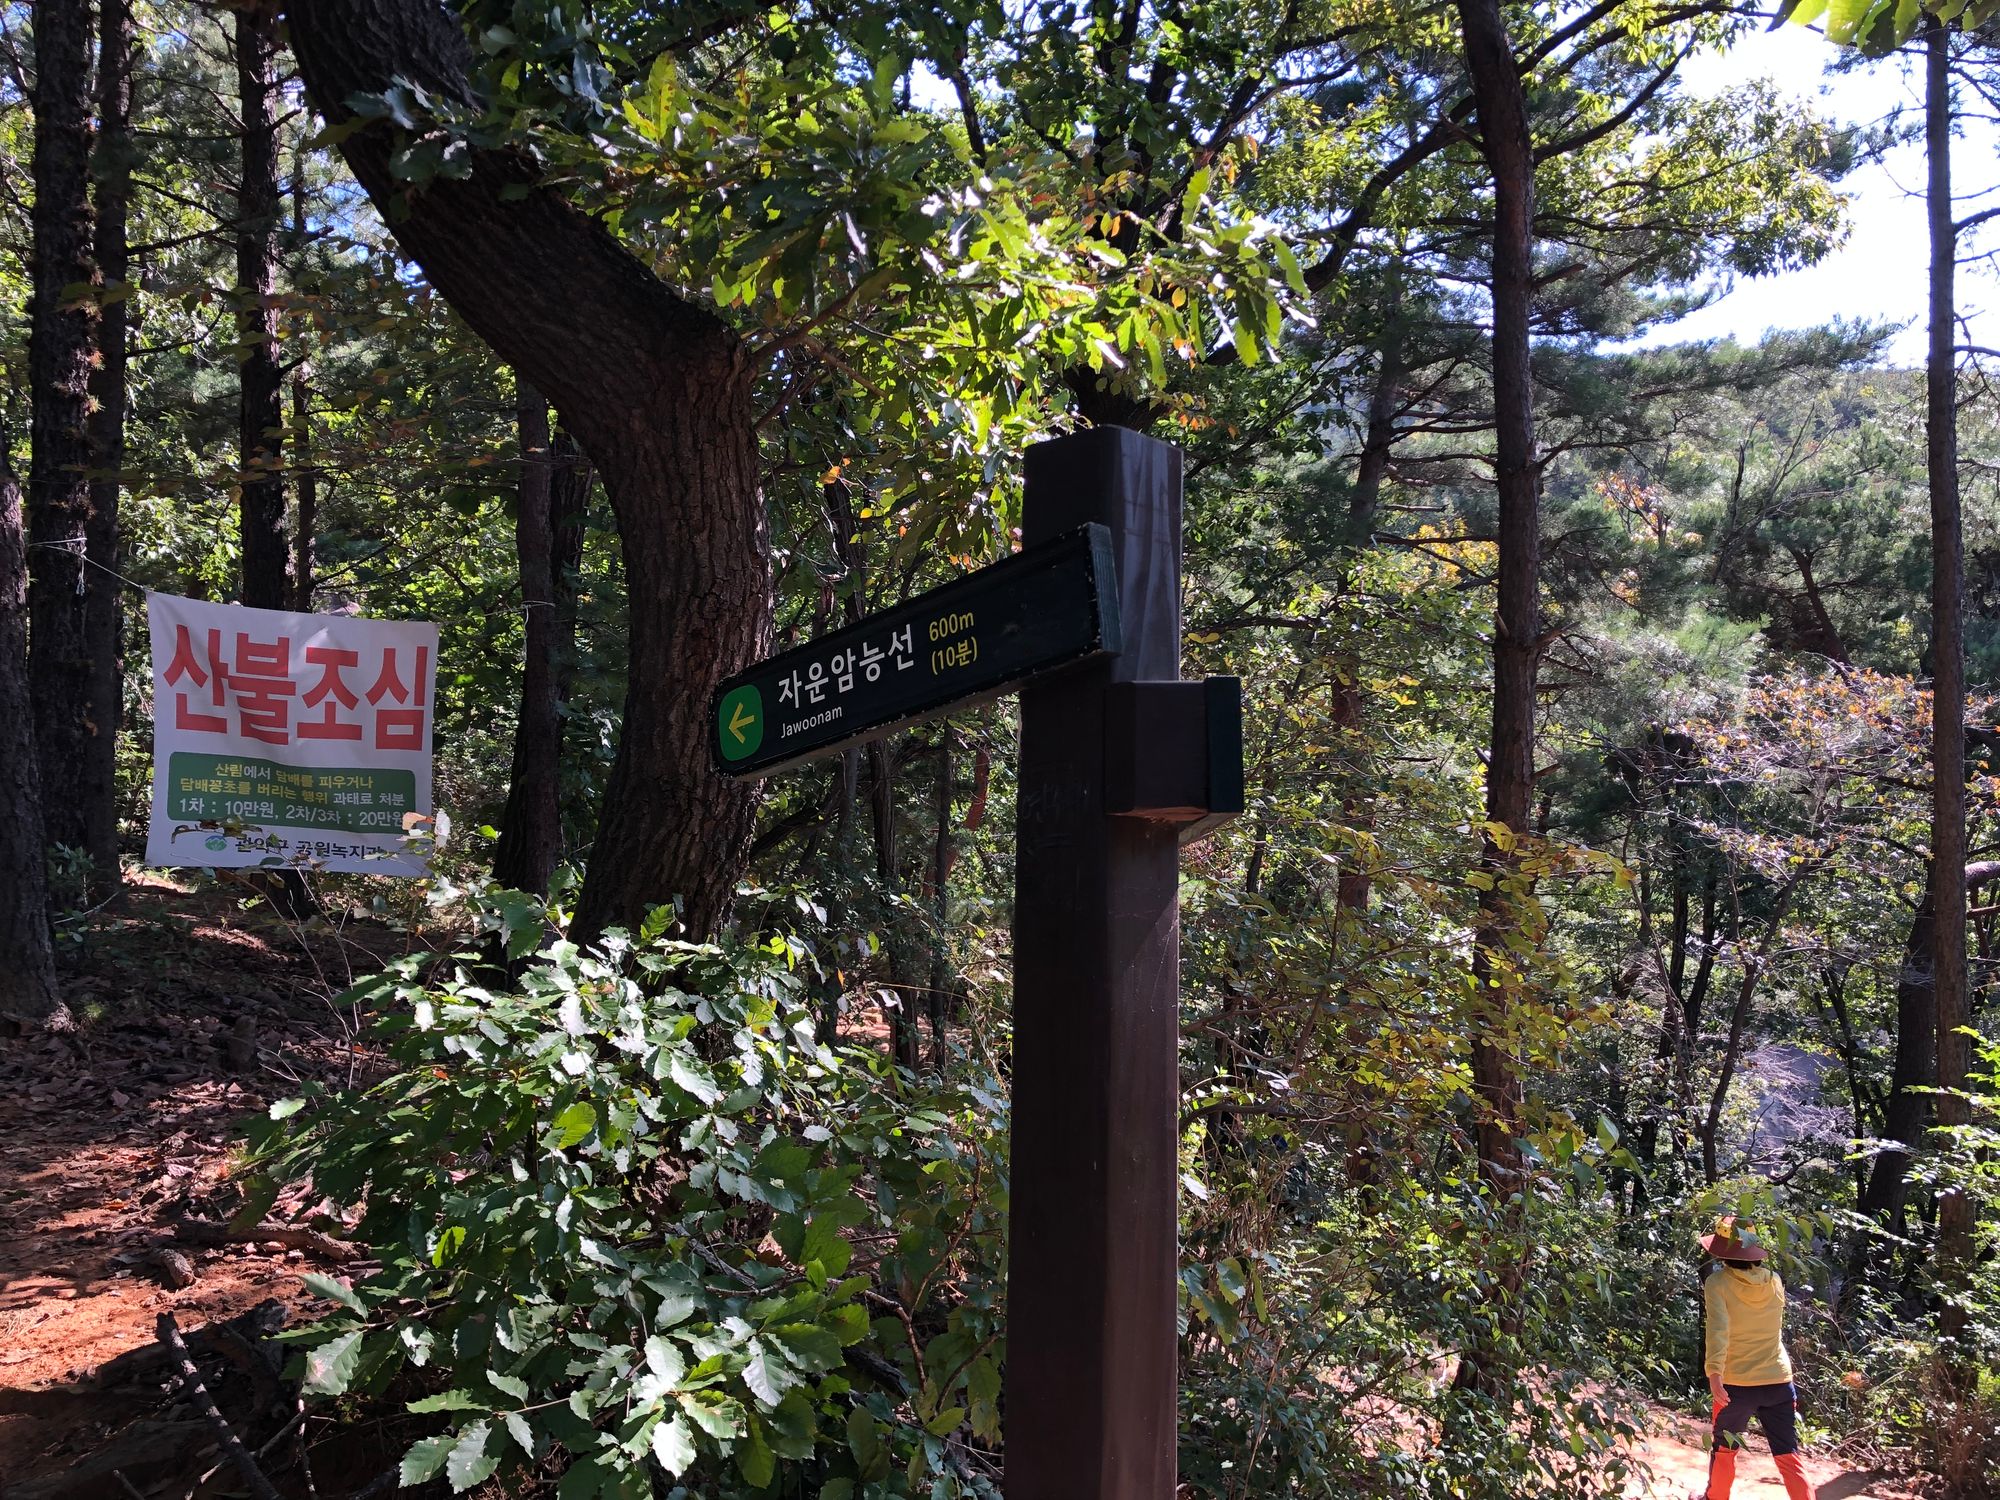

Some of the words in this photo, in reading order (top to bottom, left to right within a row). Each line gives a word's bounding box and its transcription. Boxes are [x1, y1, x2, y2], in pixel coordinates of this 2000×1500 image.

[929, 612, 975, 642] 600m
[778, 624, 914, 709] 자운암능선
[931, 636, 978, 676] (10분)
[163, 623, 429, 751] 산불조심
[780, 706, 843, 739] Jawoonam
[215, 763, 271, 780] 산림에서
[275, 769, 313, 788] 담배를
[319, 775, 374, 789] 피우거나
[180, 777, 252, 796] 담배꽁초를
[257, 783, 297, 800] 버리는
[301, 790, 328, 805] 행위
[333, 792, 373, 806] 과태료
[378, 792, 406, 807] 처분
[179, 797, 205, 815] 1차
[224, 800, 279, 820] 10만원,
[285, 804, 341, 825] 2차/3차
